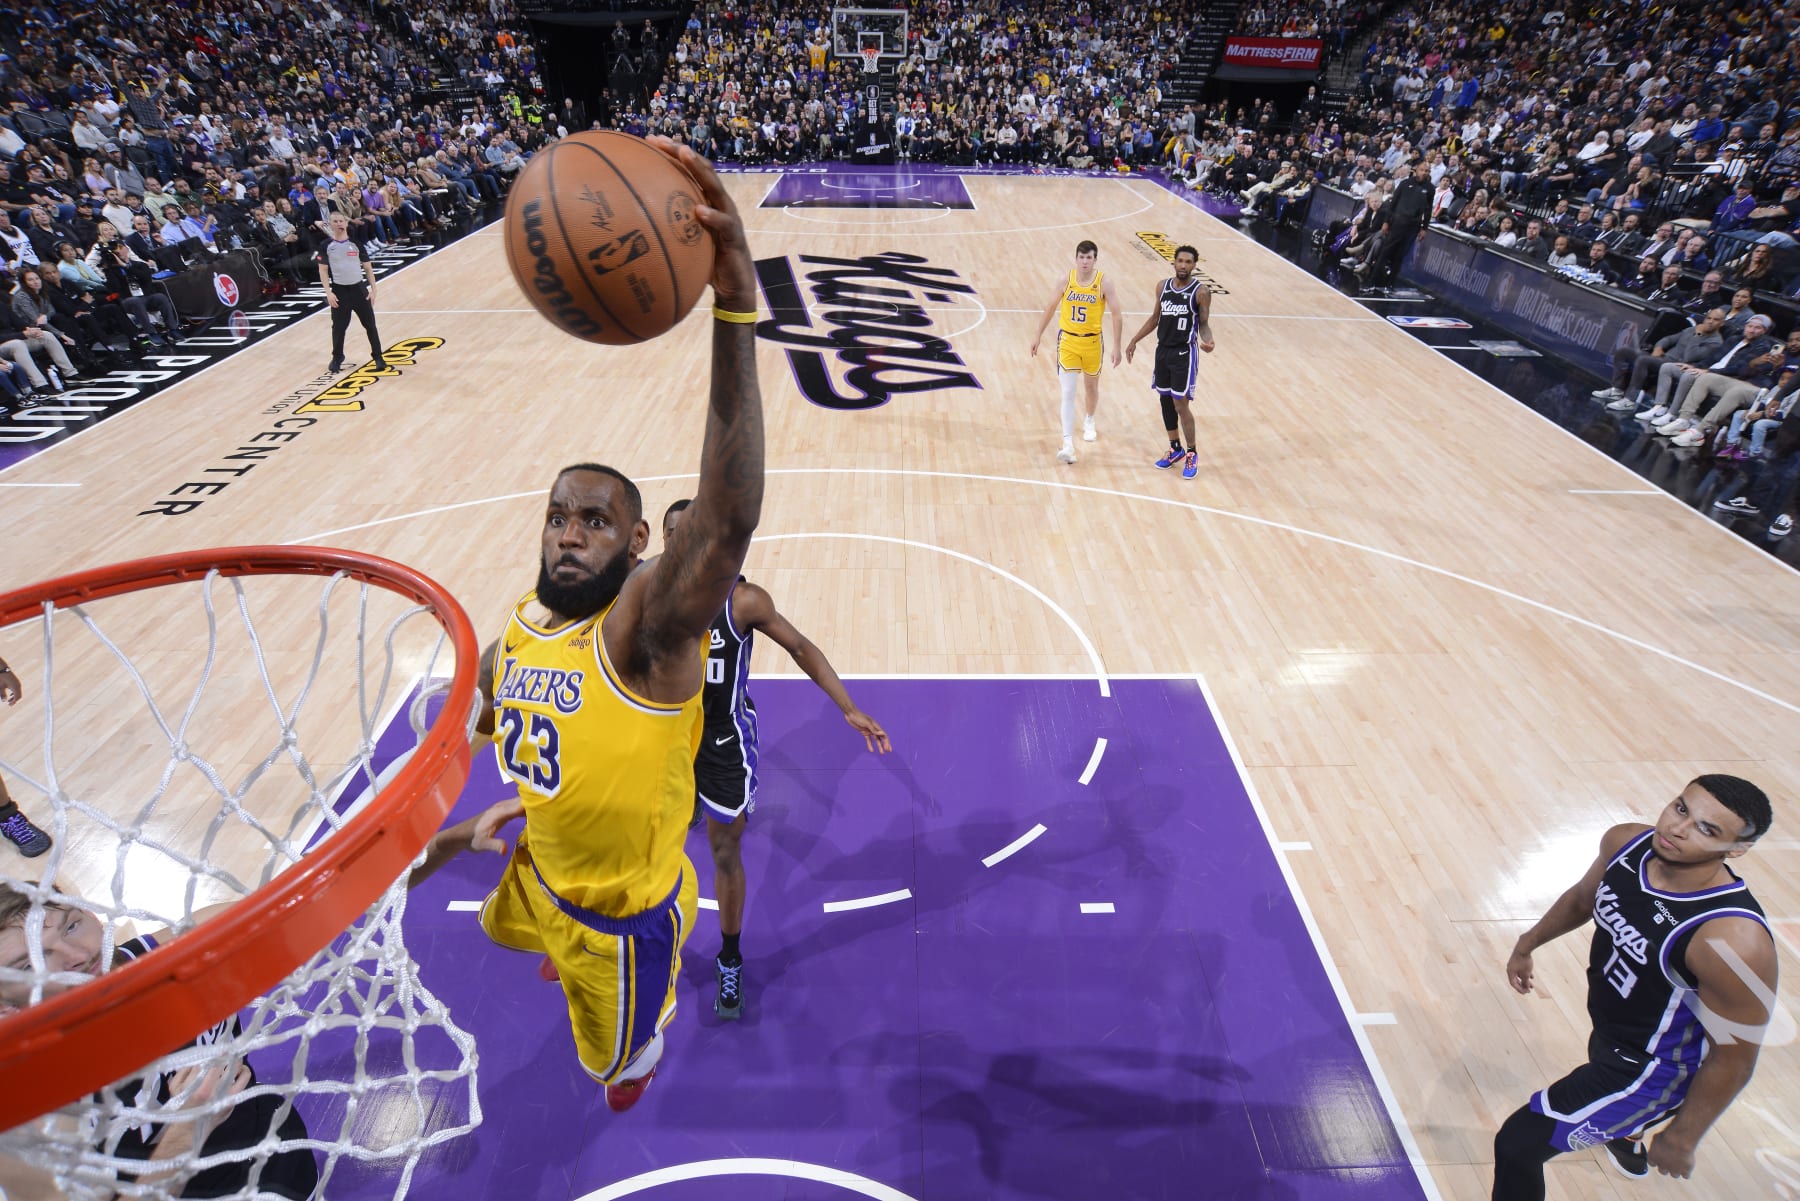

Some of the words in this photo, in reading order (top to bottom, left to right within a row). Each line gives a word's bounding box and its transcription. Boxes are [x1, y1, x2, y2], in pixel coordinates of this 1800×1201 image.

[176, 244, 435, 346] SACMENTO
[1071, 305, 1087, 323] 15
[1160, 300, 1189, 315] Kings
[752, 251, 984, 411] Kings
[1177, 317, 1187, 331] 0
[261, 389, 319, 415] Union
[136, 417, 318, 517] CENTER
[494, 658, 584, 713] LAKERS
[499, 708, 562, 799] 23
[1592, 880, 1650, 965] Kings
[1654, 900, 1680, 926] dialpad
[1603, 945, 1638, 999] 13
